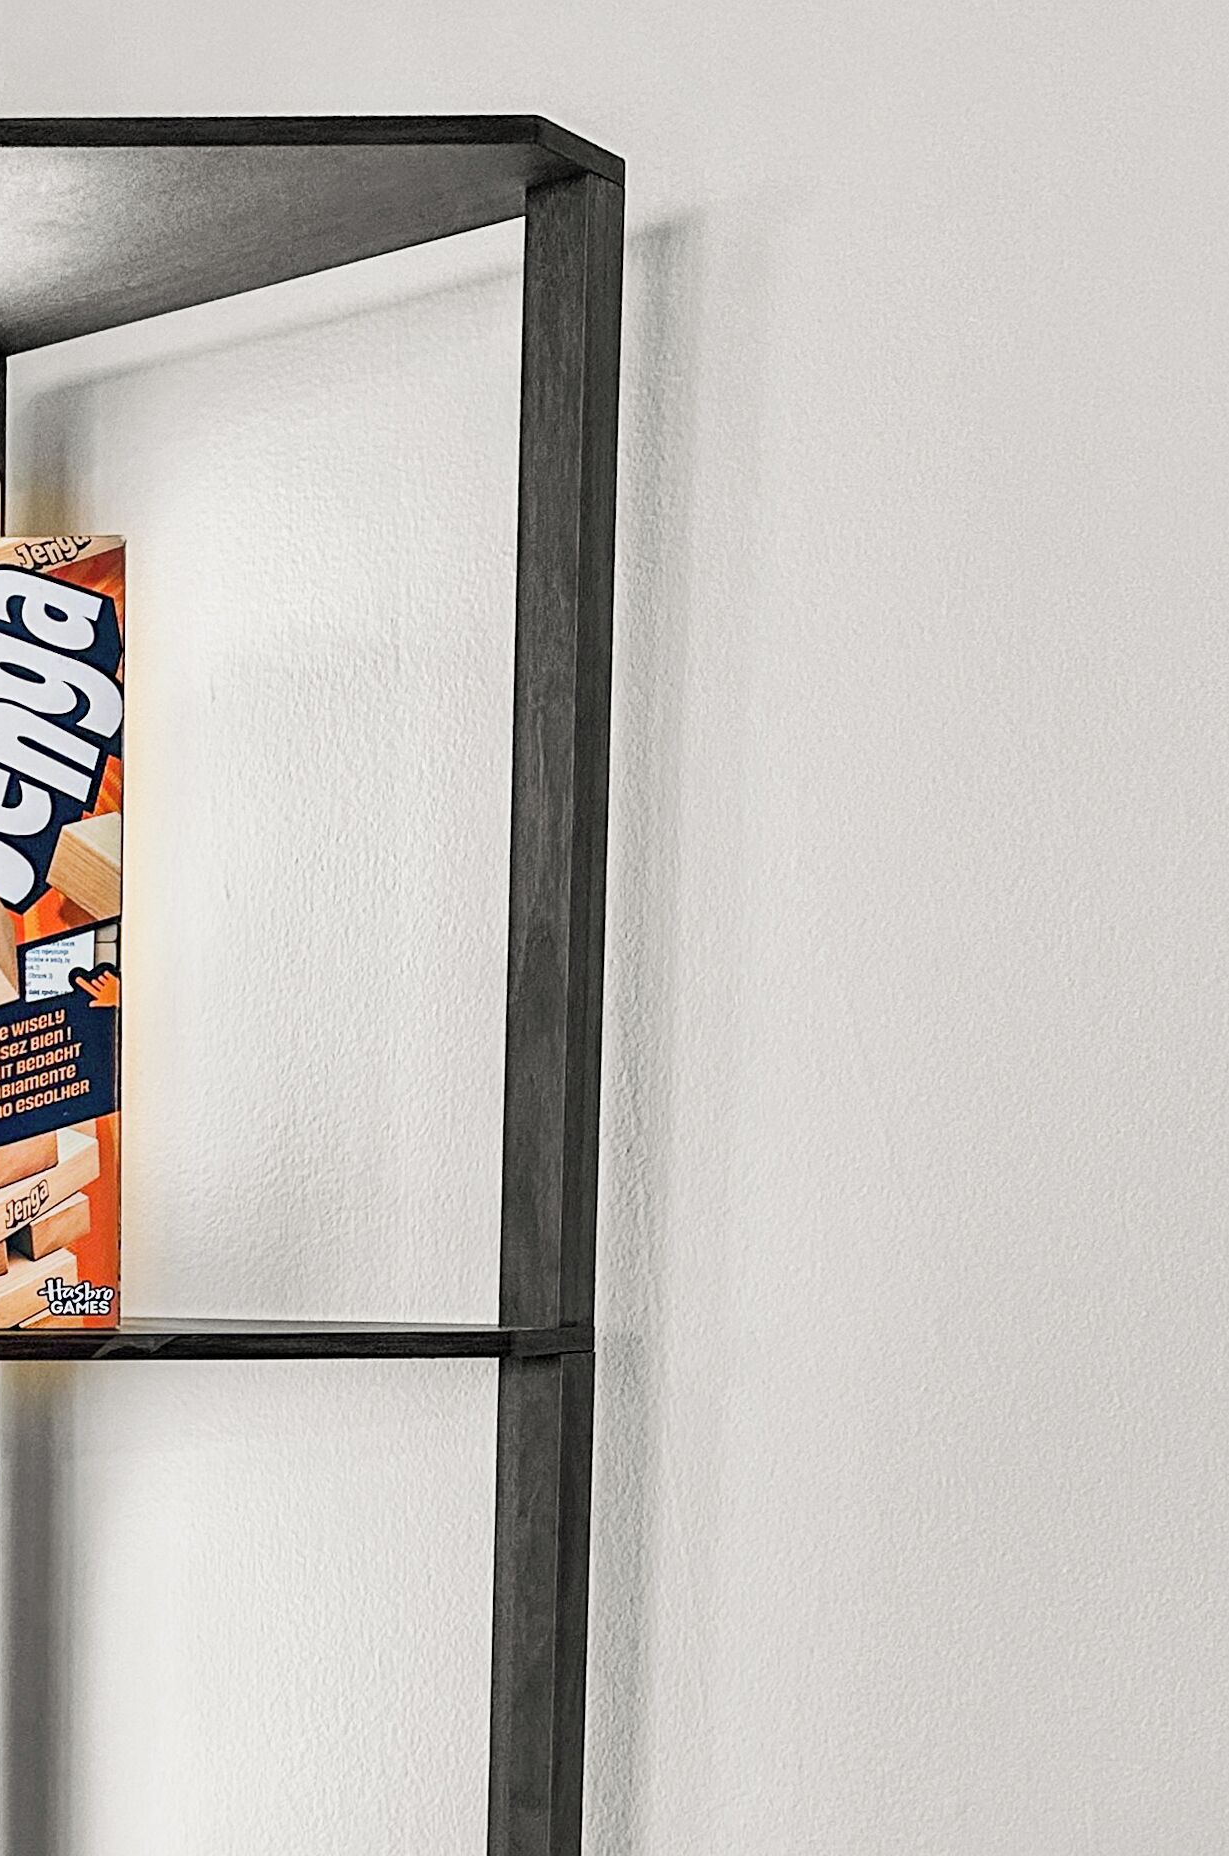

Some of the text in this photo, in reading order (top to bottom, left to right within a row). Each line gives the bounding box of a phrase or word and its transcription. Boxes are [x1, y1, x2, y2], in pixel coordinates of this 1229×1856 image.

[66, 1026, 72, 1041] !
[5, 1179, 50, 1230] Jenga
[38, 1277, 114, 1303] Hasbro
[51, 1301, 110, 1315] GAMES
